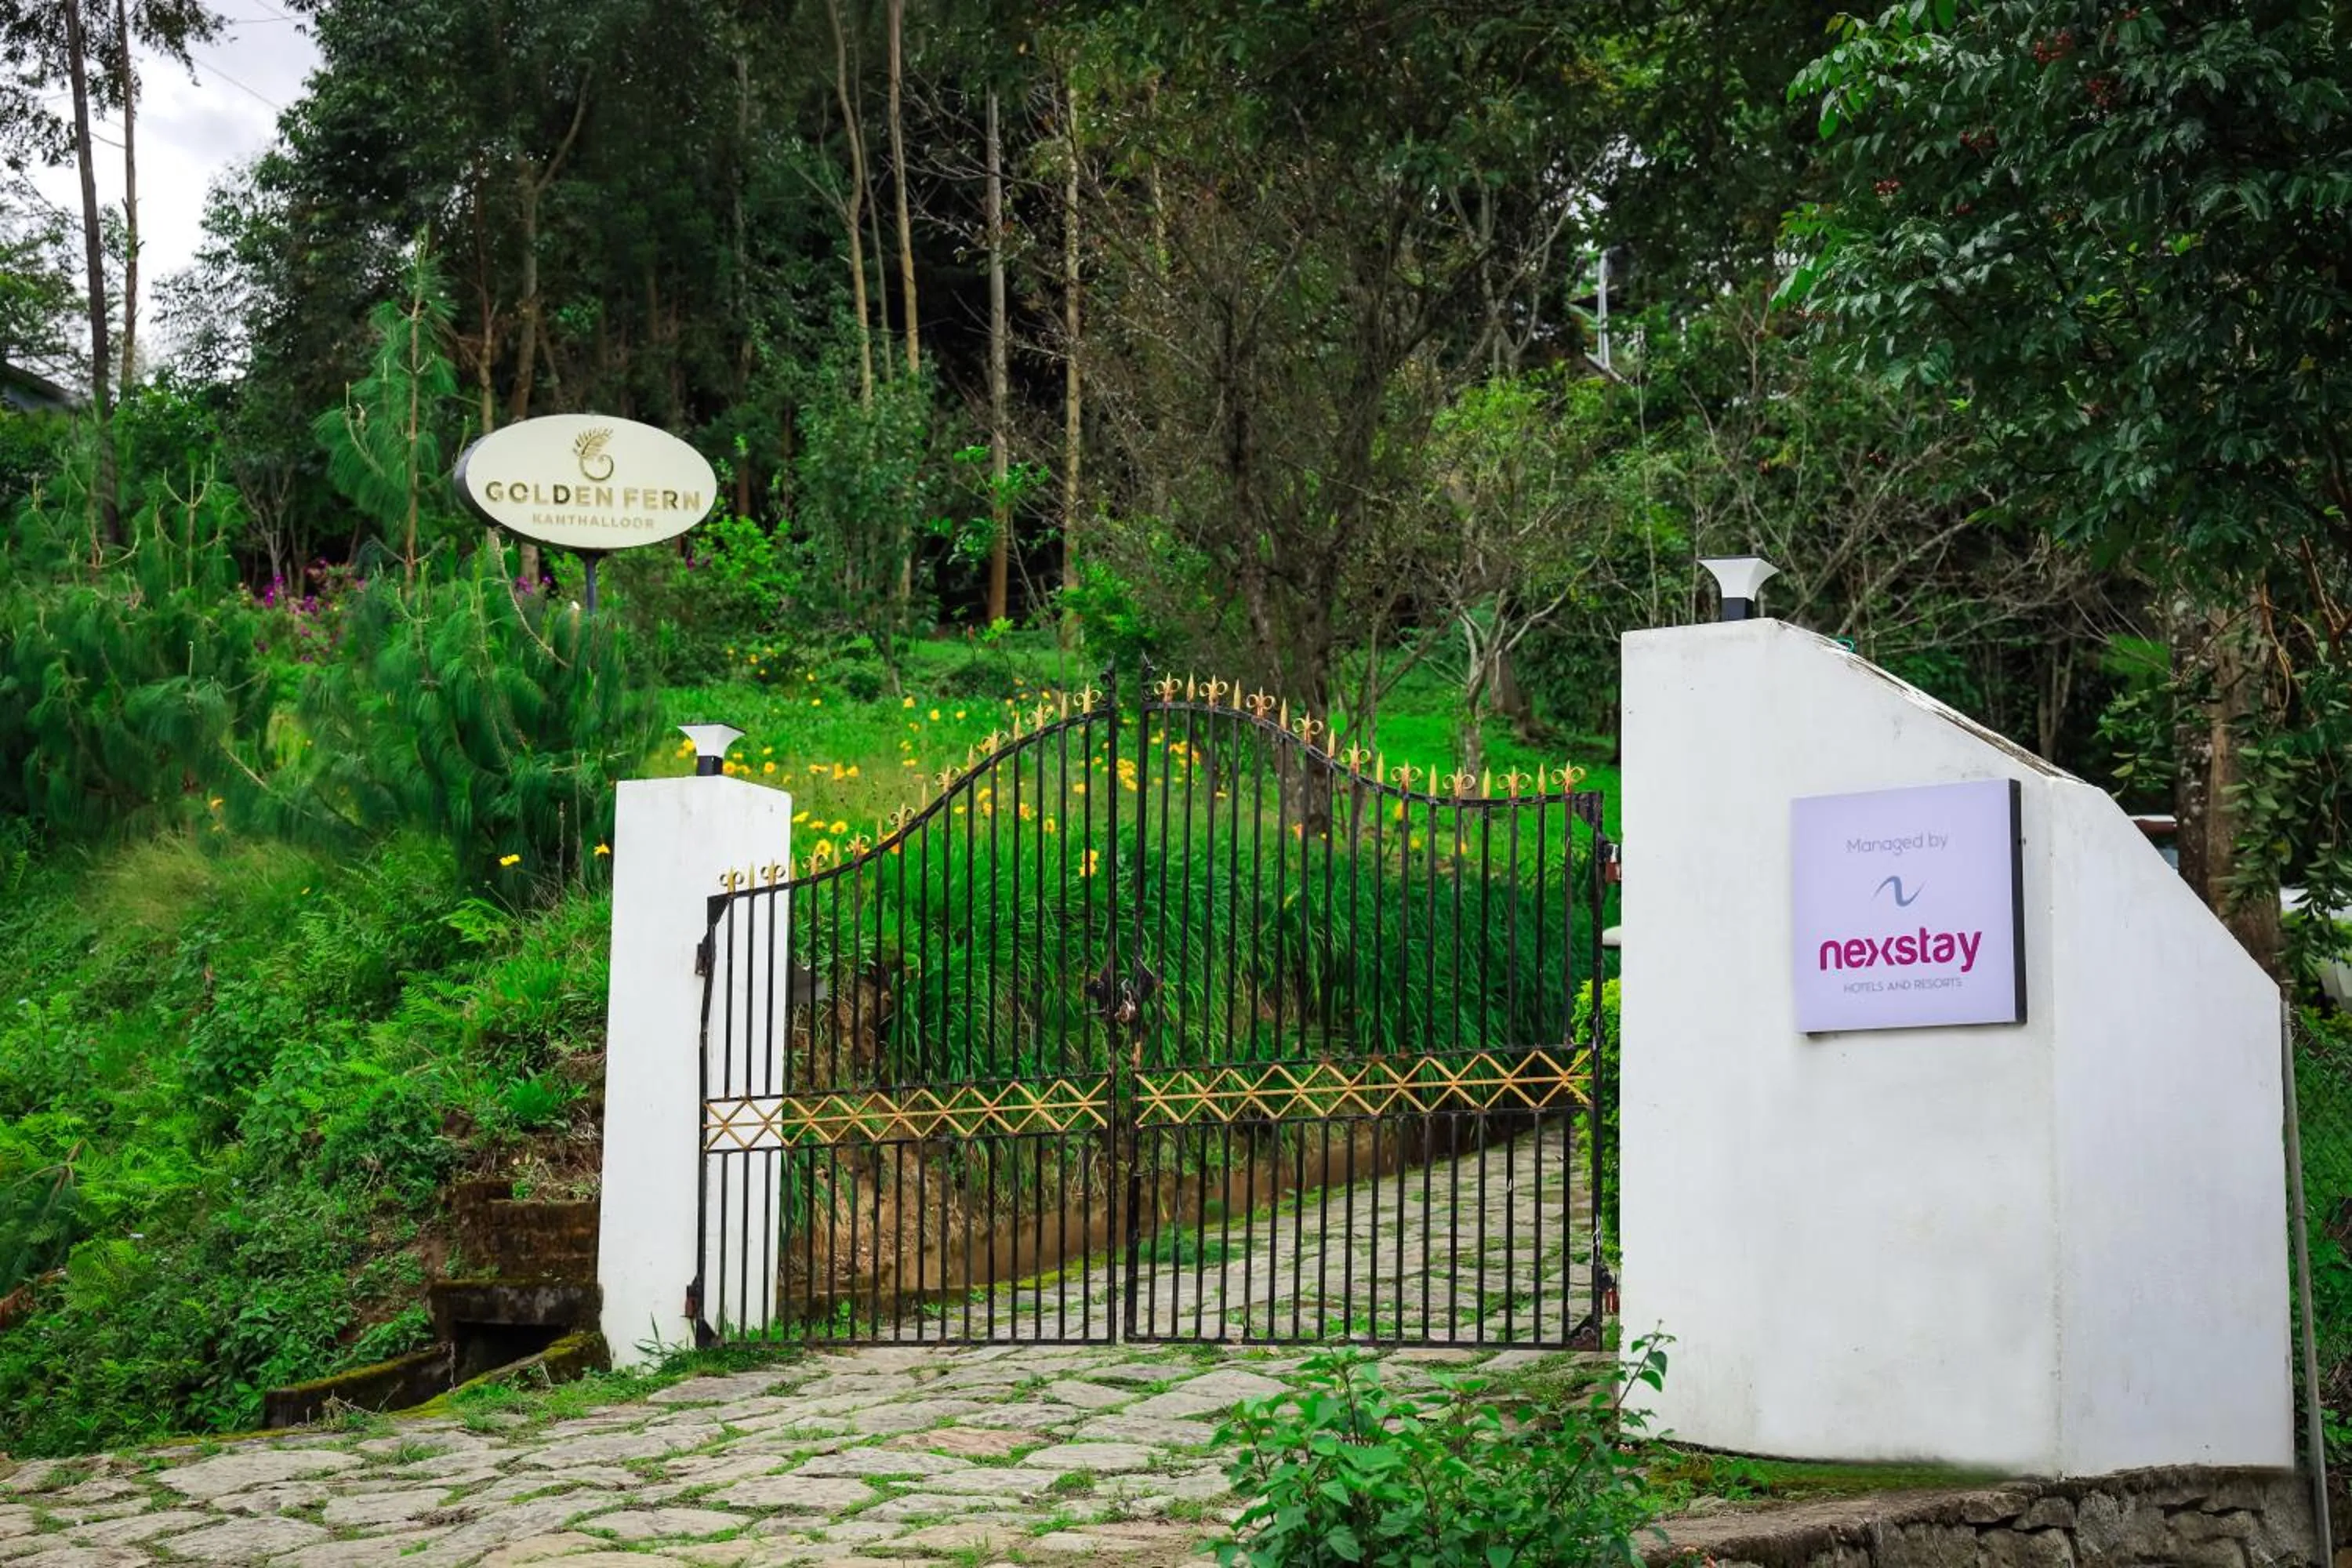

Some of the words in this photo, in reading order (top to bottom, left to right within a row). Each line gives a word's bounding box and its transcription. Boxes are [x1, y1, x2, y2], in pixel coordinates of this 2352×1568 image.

[485, 481, 613, 507] GOLDEN
[623, 488, 700, 511] FERN
[532, 513, 655, 528] KANTHALLOOR
[1846, 833, 1923, 855] Managed
[1928, 832, 1948, 851] by
[1820, 927, 1982, 972] nexstay
[1844, 981, 1883, 994] HOTELS
[1887, 979, 1911, 992] AND
[1914, 977, 1962, 990] RESORTS
